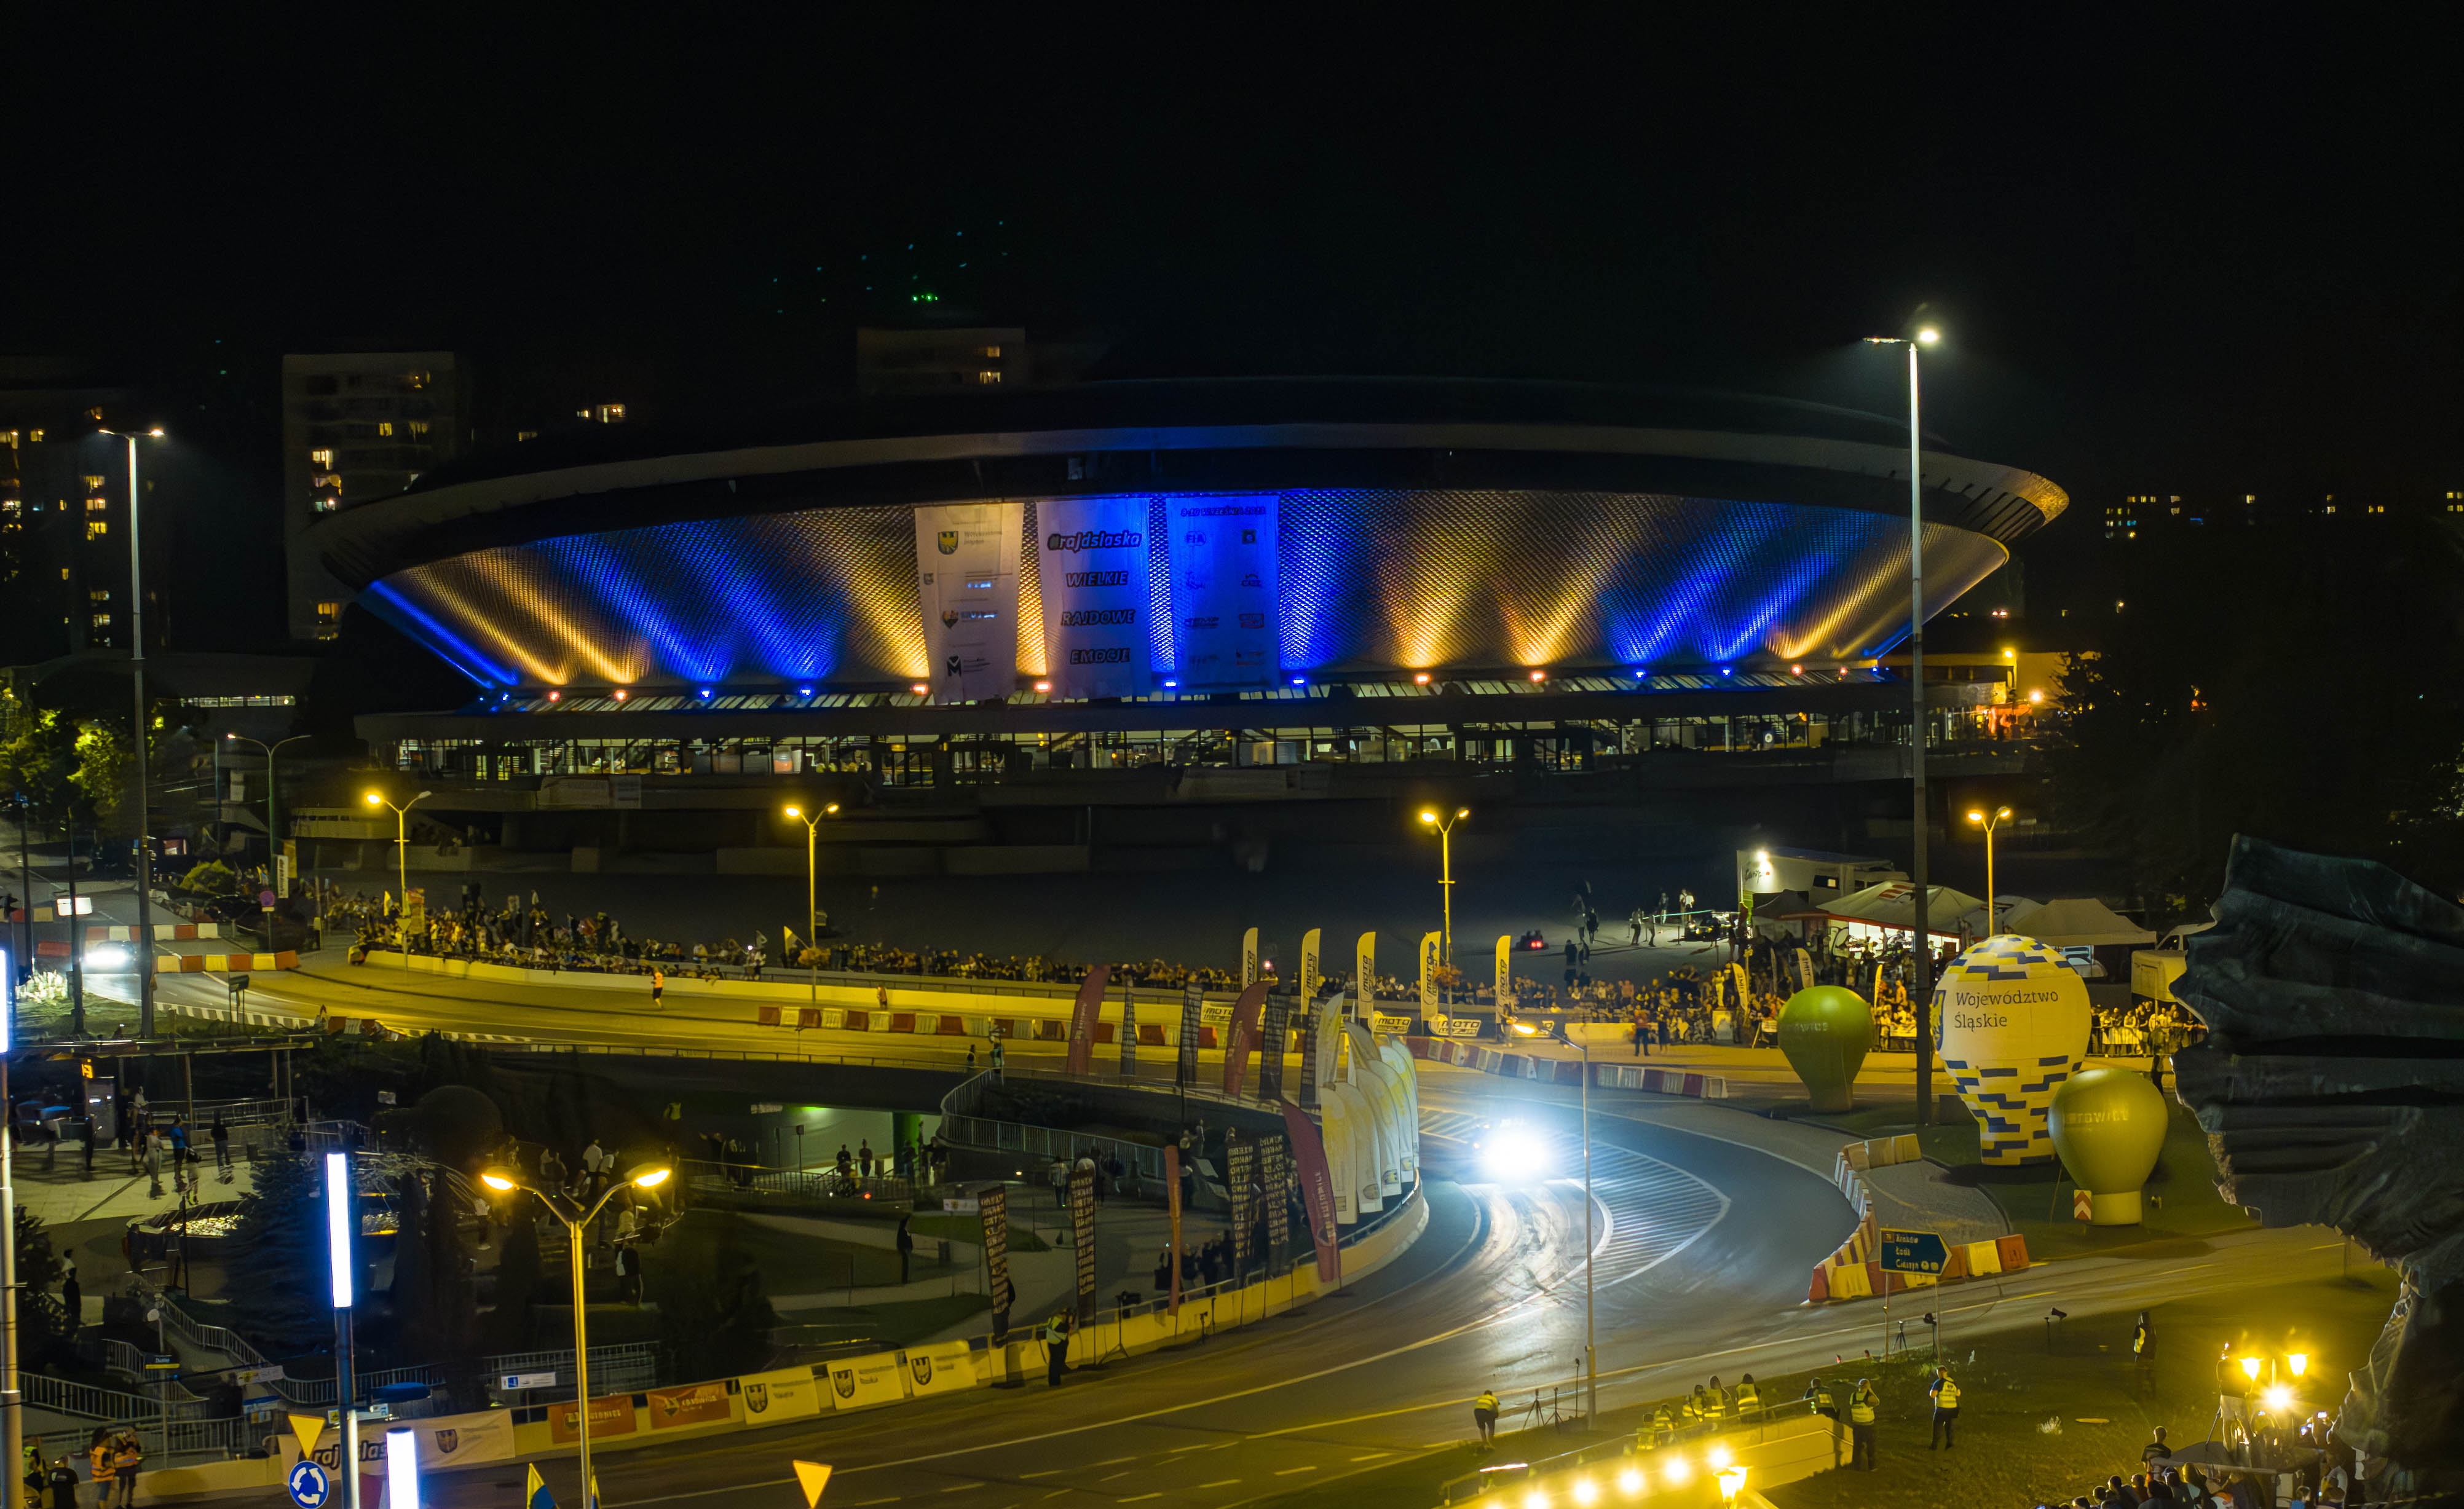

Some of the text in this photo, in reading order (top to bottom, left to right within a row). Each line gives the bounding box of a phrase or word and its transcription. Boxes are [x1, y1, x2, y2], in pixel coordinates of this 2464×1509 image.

[1066, 571, 1129, 588] WIELKIE
[1061, 609, 1136, 626] RAJDOWE
[1956, 990, 2058, 1009] Województwo
[1954, 1011, 2007, 1032] Śląskie
